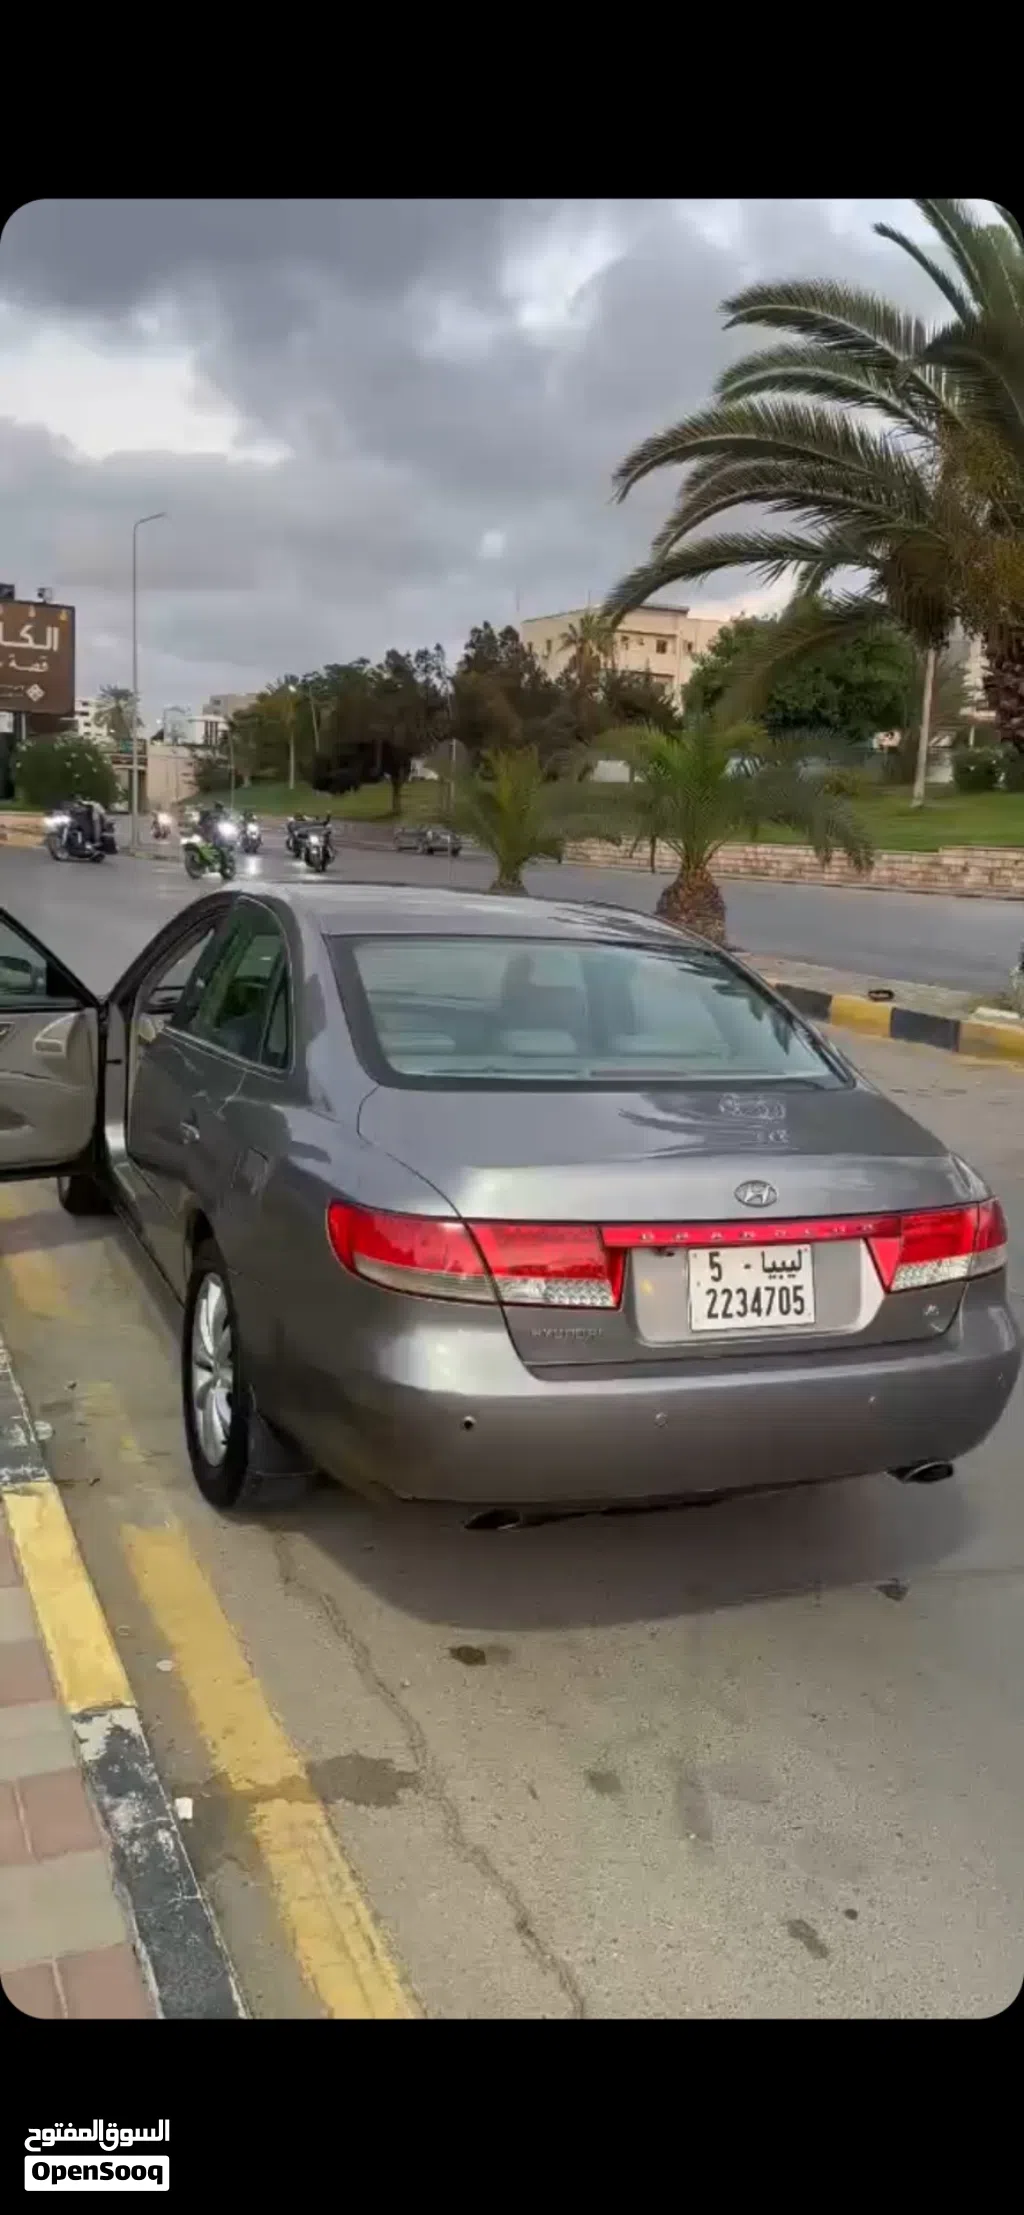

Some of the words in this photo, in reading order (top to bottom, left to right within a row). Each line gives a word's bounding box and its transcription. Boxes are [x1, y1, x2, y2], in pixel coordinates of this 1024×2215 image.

[708, 1251, 722, 1282] 5
[761, 1249, 802, 1280] ليبيا
[706, 1285, 805, 1319] 2234705
